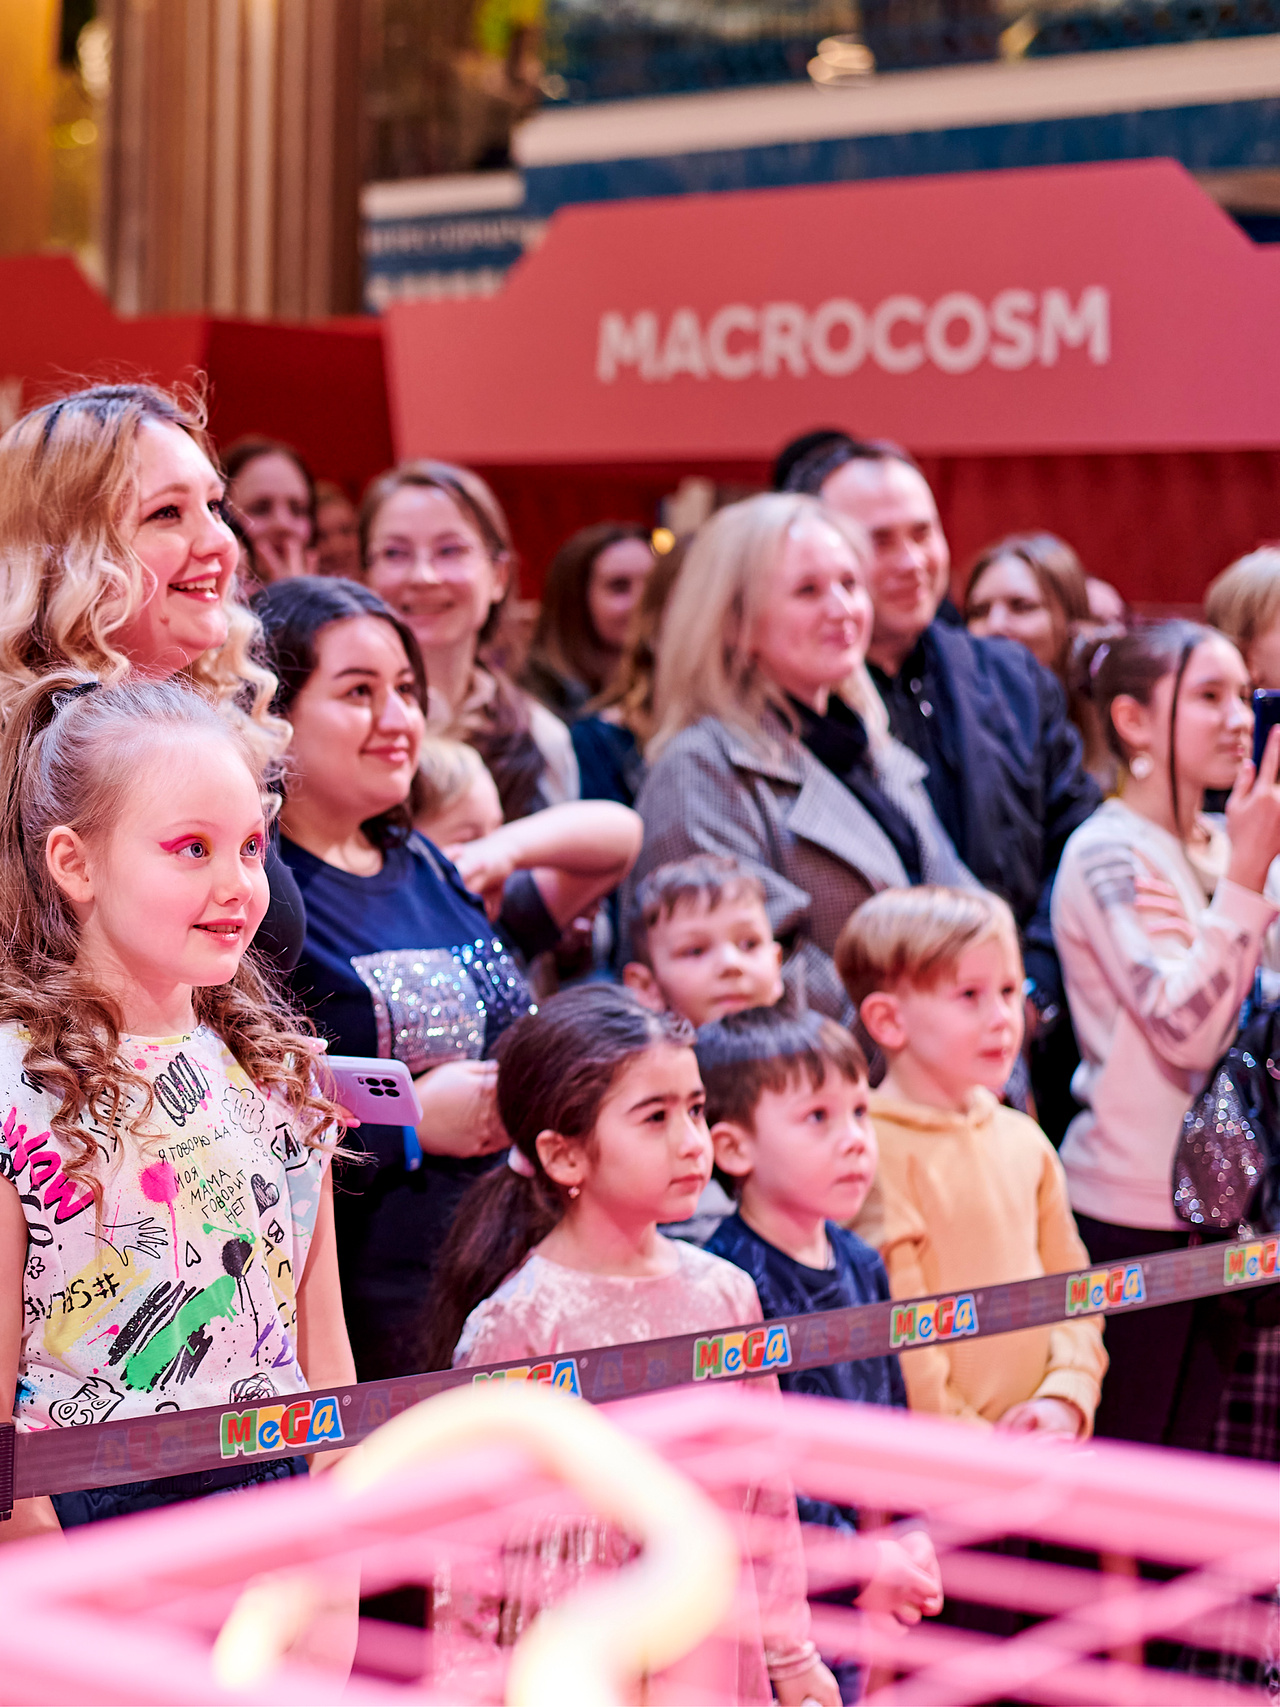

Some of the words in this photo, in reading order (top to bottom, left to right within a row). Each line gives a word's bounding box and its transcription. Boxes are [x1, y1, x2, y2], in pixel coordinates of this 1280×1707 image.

[594, 285, 1111, 384] MACROCOSM
[158, 1149, 169, 1166] Я
[168, 1135, 211, 1161] ГОВОРЮ
[214, 1126, 231, 1141] ДА
[173, 1166, 199, 1193] МОЯ
[190, 1168, 231, 1205] МАМА
[201, 1168, 247, 1219] ГОВОРИТ
[224, 1196, 246, 1224] НЕТ
